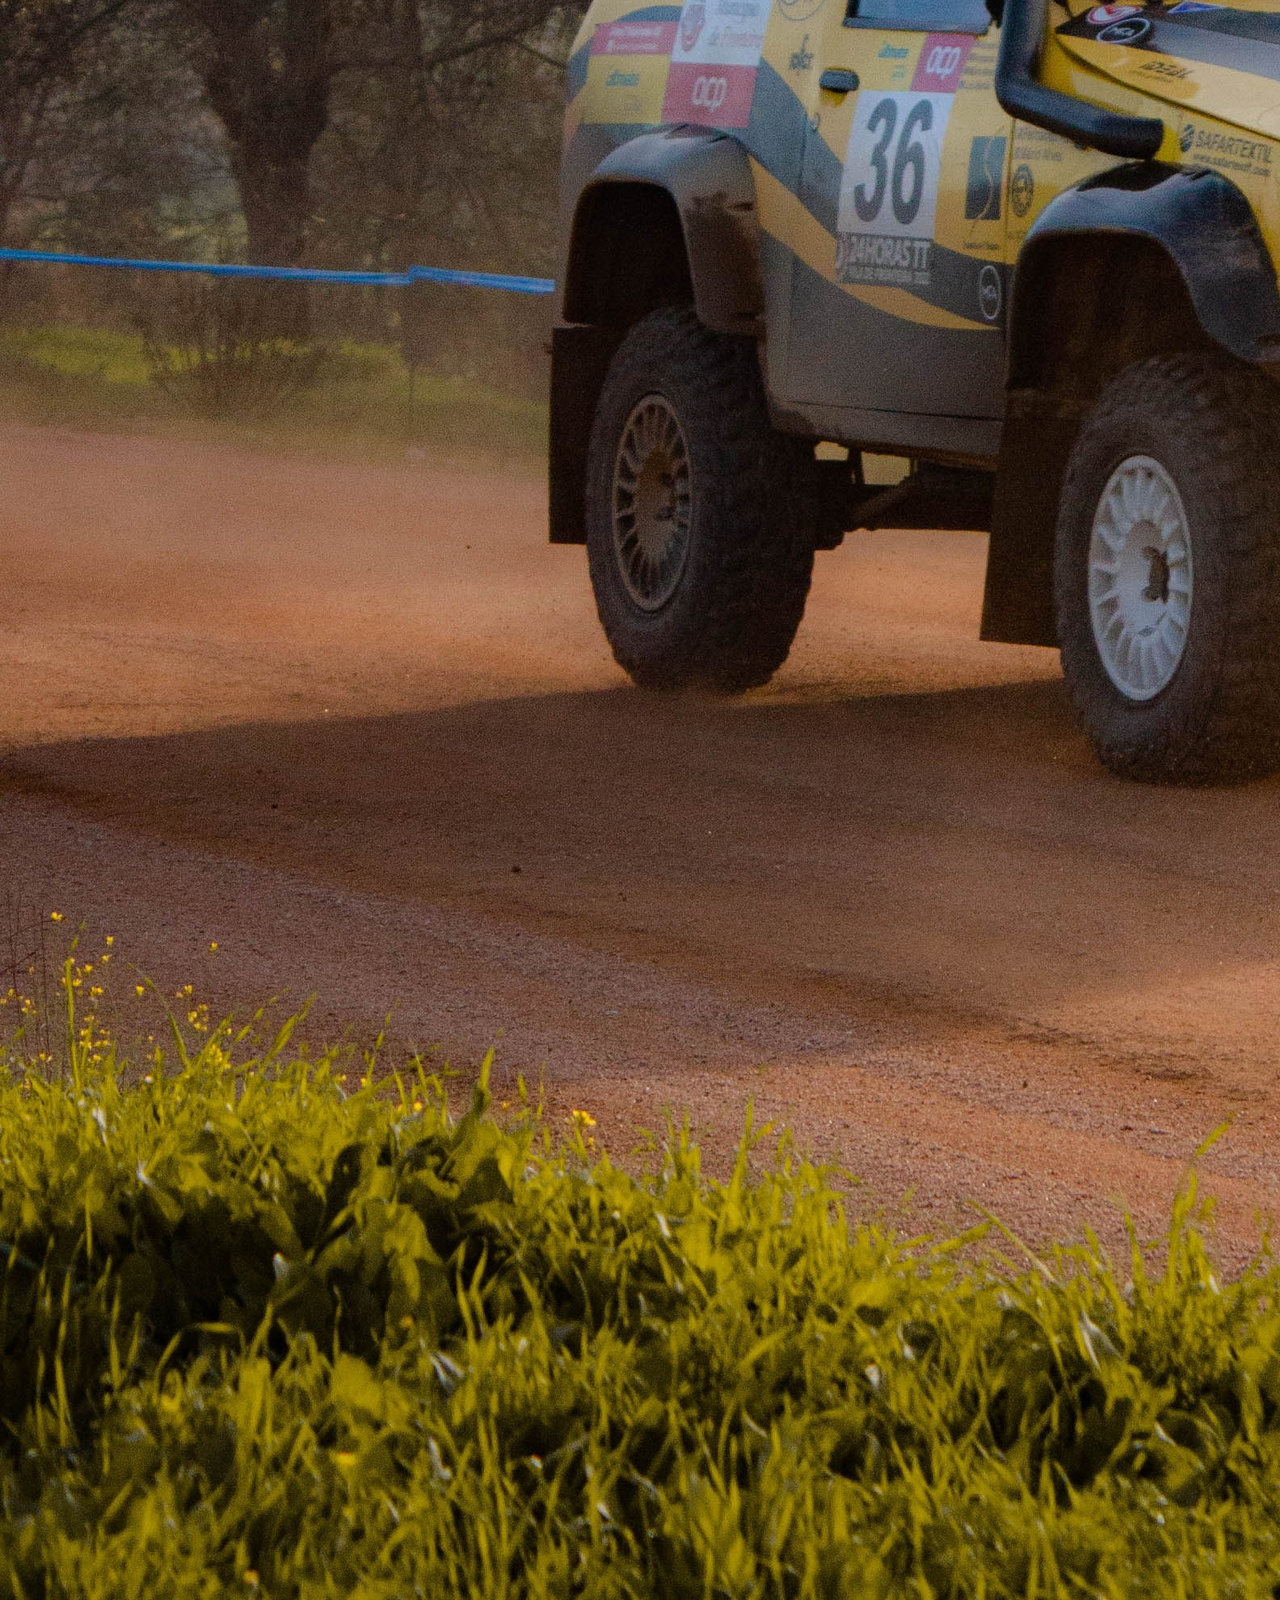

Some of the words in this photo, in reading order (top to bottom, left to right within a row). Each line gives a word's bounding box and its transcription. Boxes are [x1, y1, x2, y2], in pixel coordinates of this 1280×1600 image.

[925, 46, 961, 80] acp
[692, 77, 728, 112] acp
[853, 98, 934, 225] 36
[849, 236, 912, 268] 24HORAS
[913, 240, 932, 269] TT
